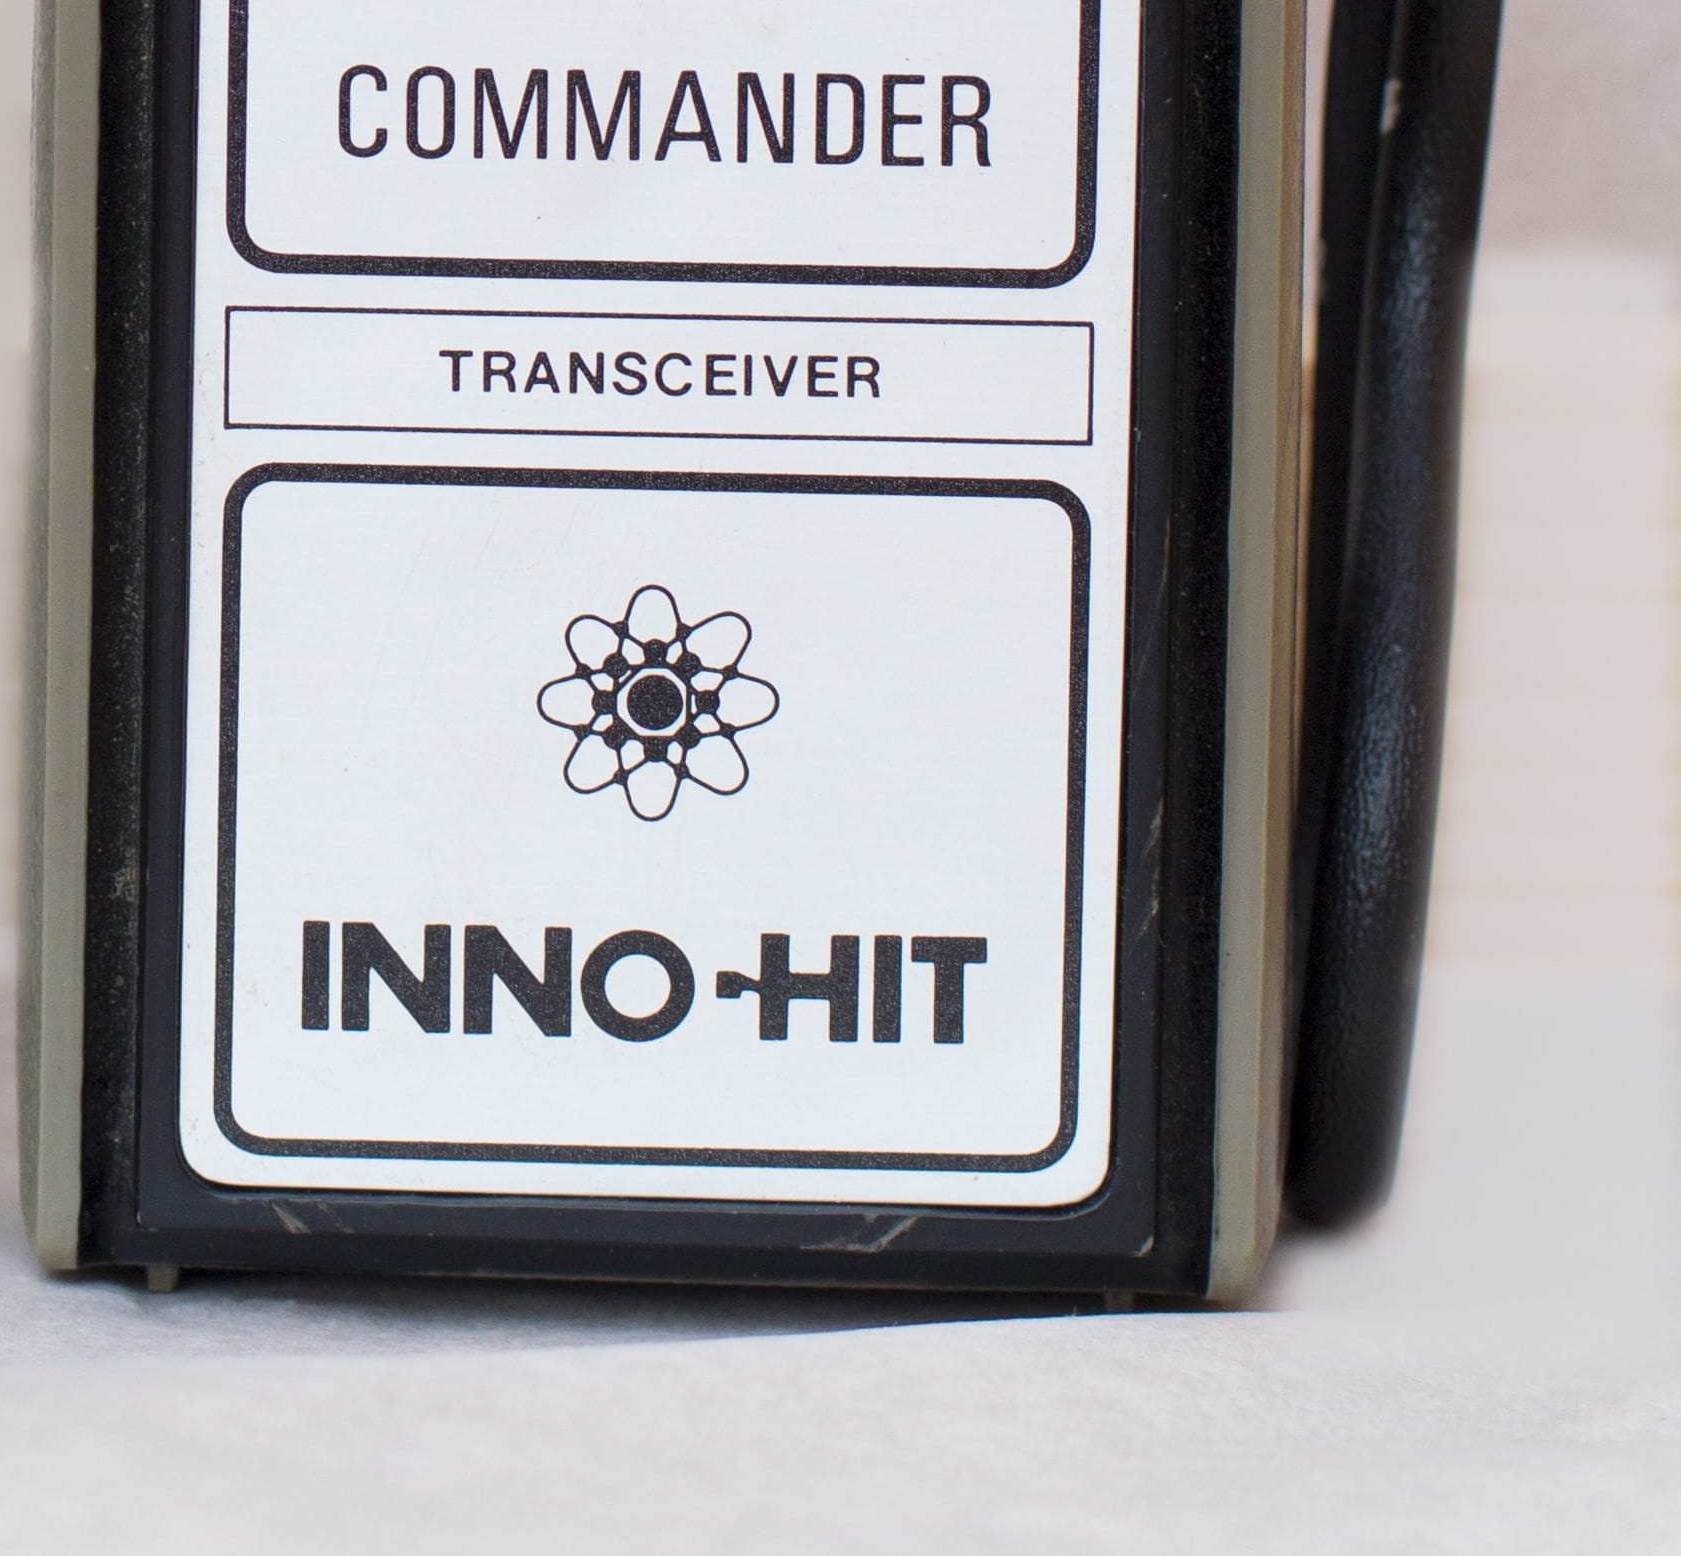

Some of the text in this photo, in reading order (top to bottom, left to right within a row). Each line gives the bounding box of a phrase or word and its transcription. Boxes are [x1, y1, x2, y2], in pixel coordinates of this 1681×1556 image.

[337, 63, 992, 168] COMMANDER
[438, 349, 881, 399] TRANSCEIVER
[300, 919, 989, 1045] INNO-HIT
